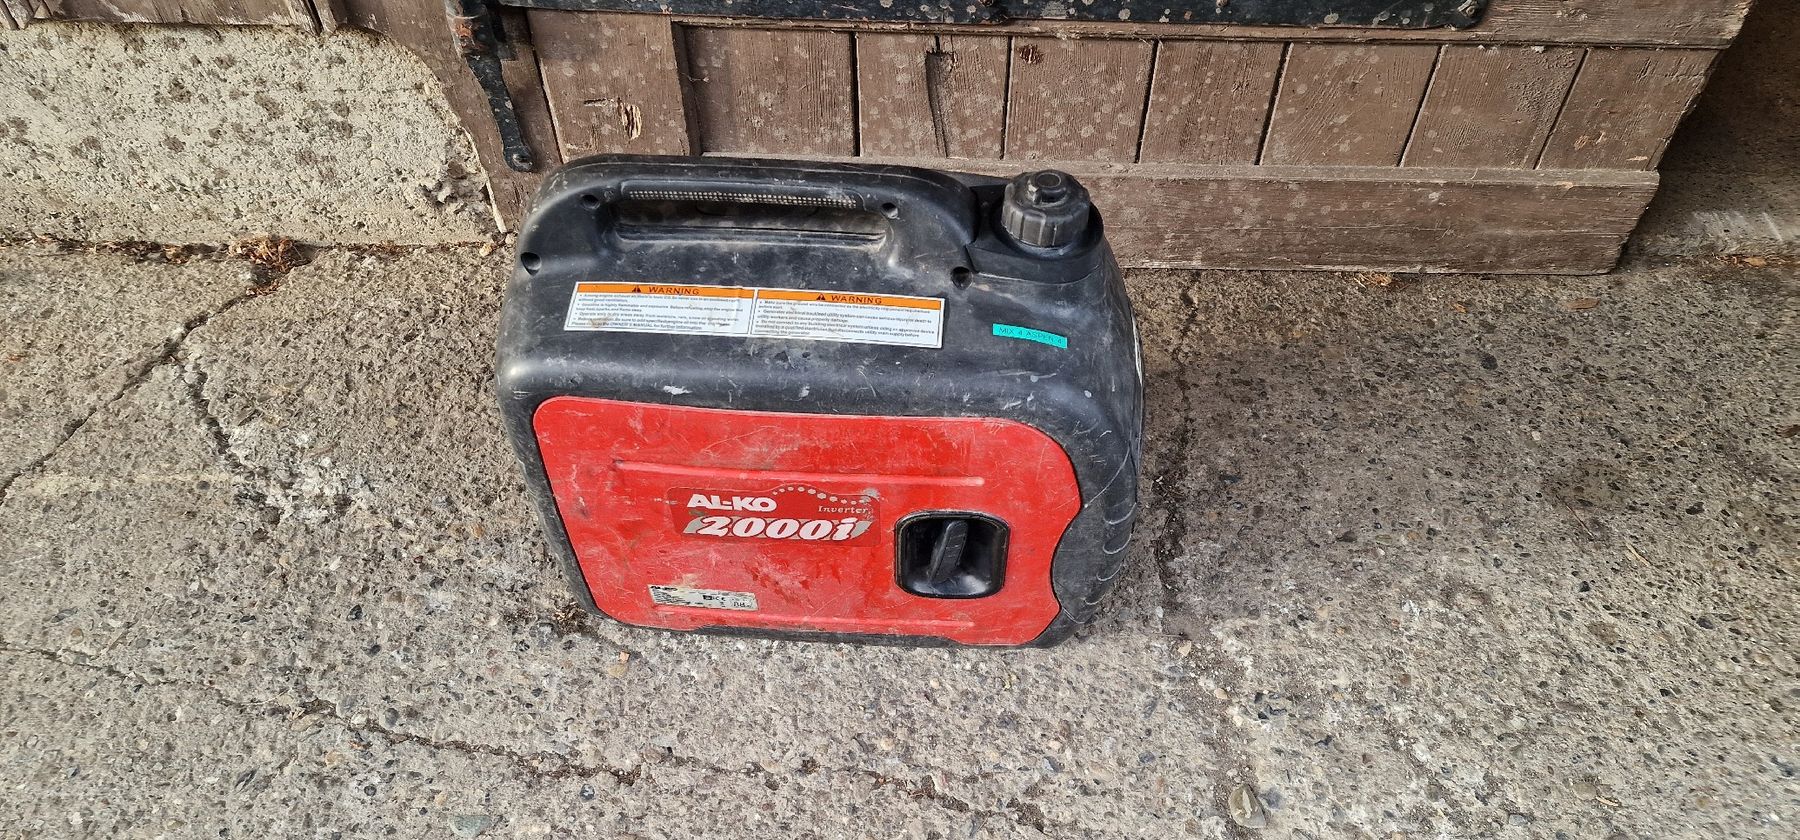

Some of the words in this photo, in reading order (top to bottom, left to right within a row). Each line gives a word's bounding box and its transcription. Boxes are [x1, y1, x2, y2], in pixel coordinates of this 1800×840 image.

[649, 286, 700, 295] WARNING
[831, 295, 882, 304] WARNING
[1000, 326, 1015, 335] MIX
[1026, 331, 1054, 342] ASPEN
[687, 493, 778, 512] AL-KO
[818, 505, 869, 514] Inverter
[697, 516, 858, 541] 2000i
